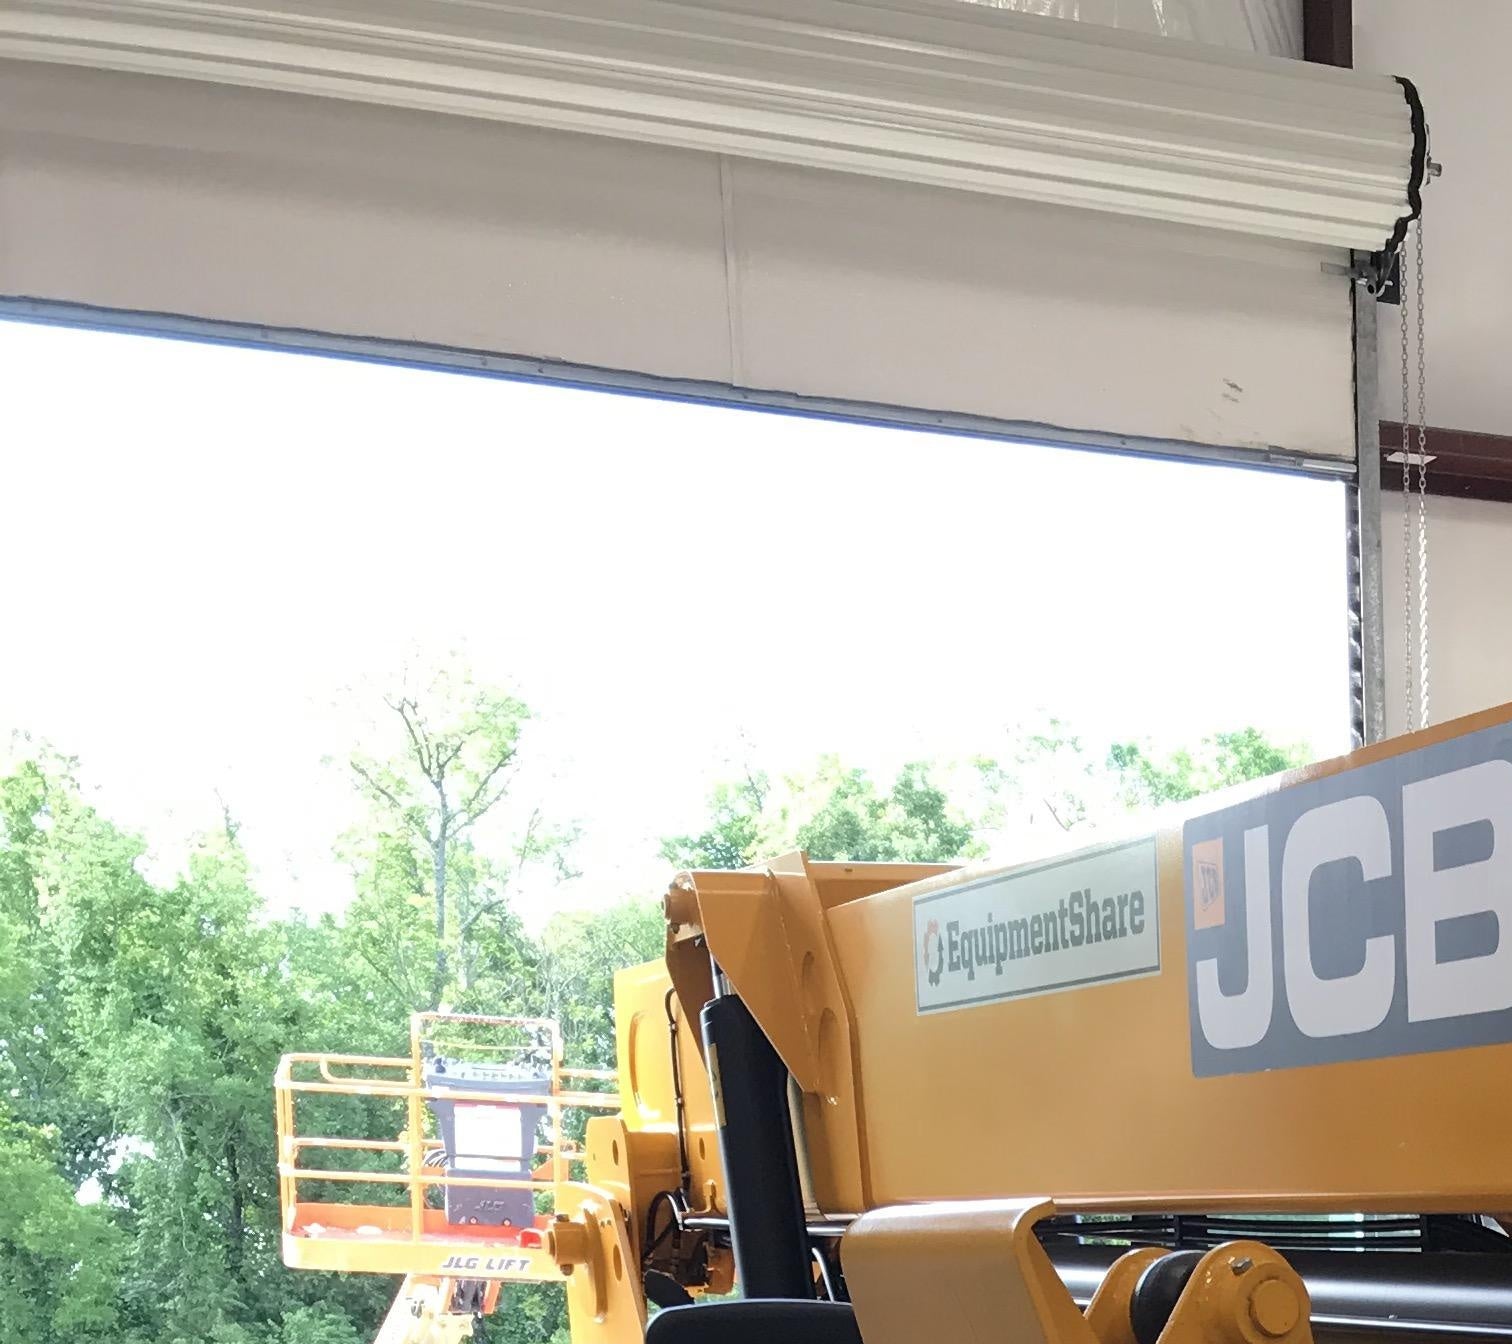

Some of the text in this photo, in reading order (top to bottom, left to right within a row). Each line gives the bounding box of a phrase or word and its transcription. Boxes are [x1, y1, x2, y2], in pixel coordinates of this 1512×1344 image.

[945, 887, 1146, 981] EquipmentShare
[442, 1256, 531, 1272] JLG LIFT
